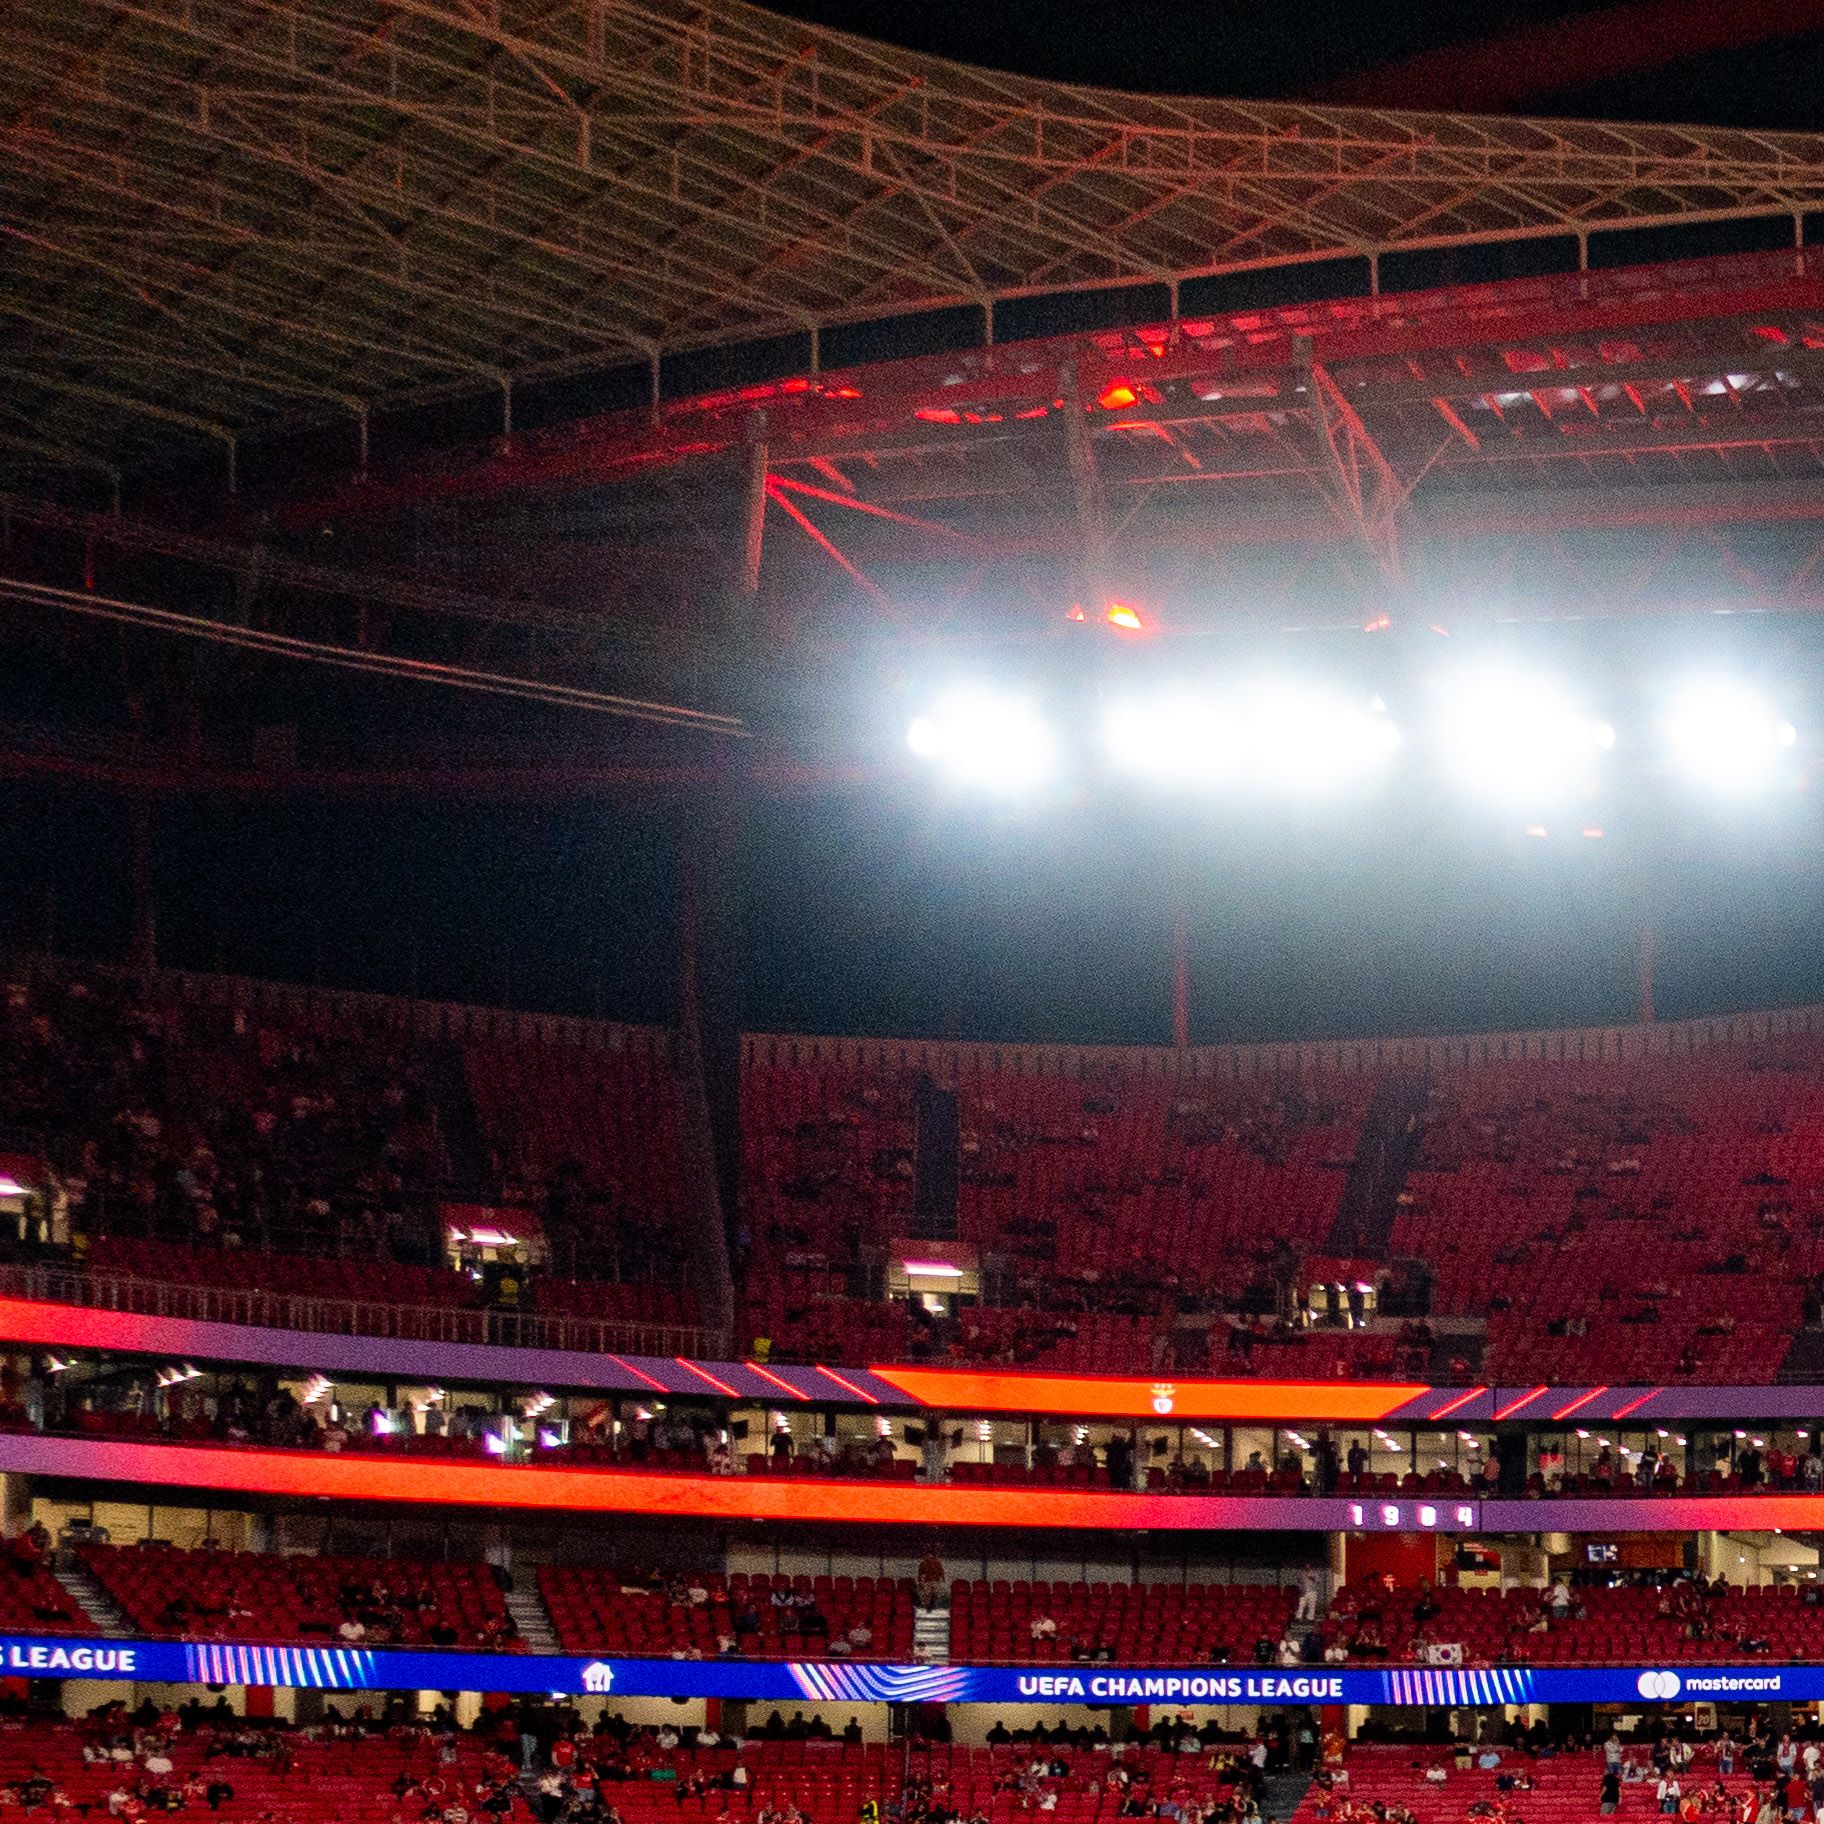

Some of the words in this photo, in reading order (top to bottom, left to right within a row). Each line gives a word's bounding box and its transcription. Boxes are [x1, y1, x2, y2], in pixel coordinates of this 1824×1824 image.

[11, 1645, 136, 1672] LEAGUE
[1019, 1676, 1085, 1696] UEFA
[1091, 1676, 1242, 1698] CHAMPIONS
[1247, 1677, 1343, 1698] LEAGUE
[1686, 1675, 1781, 1691] mastercard
